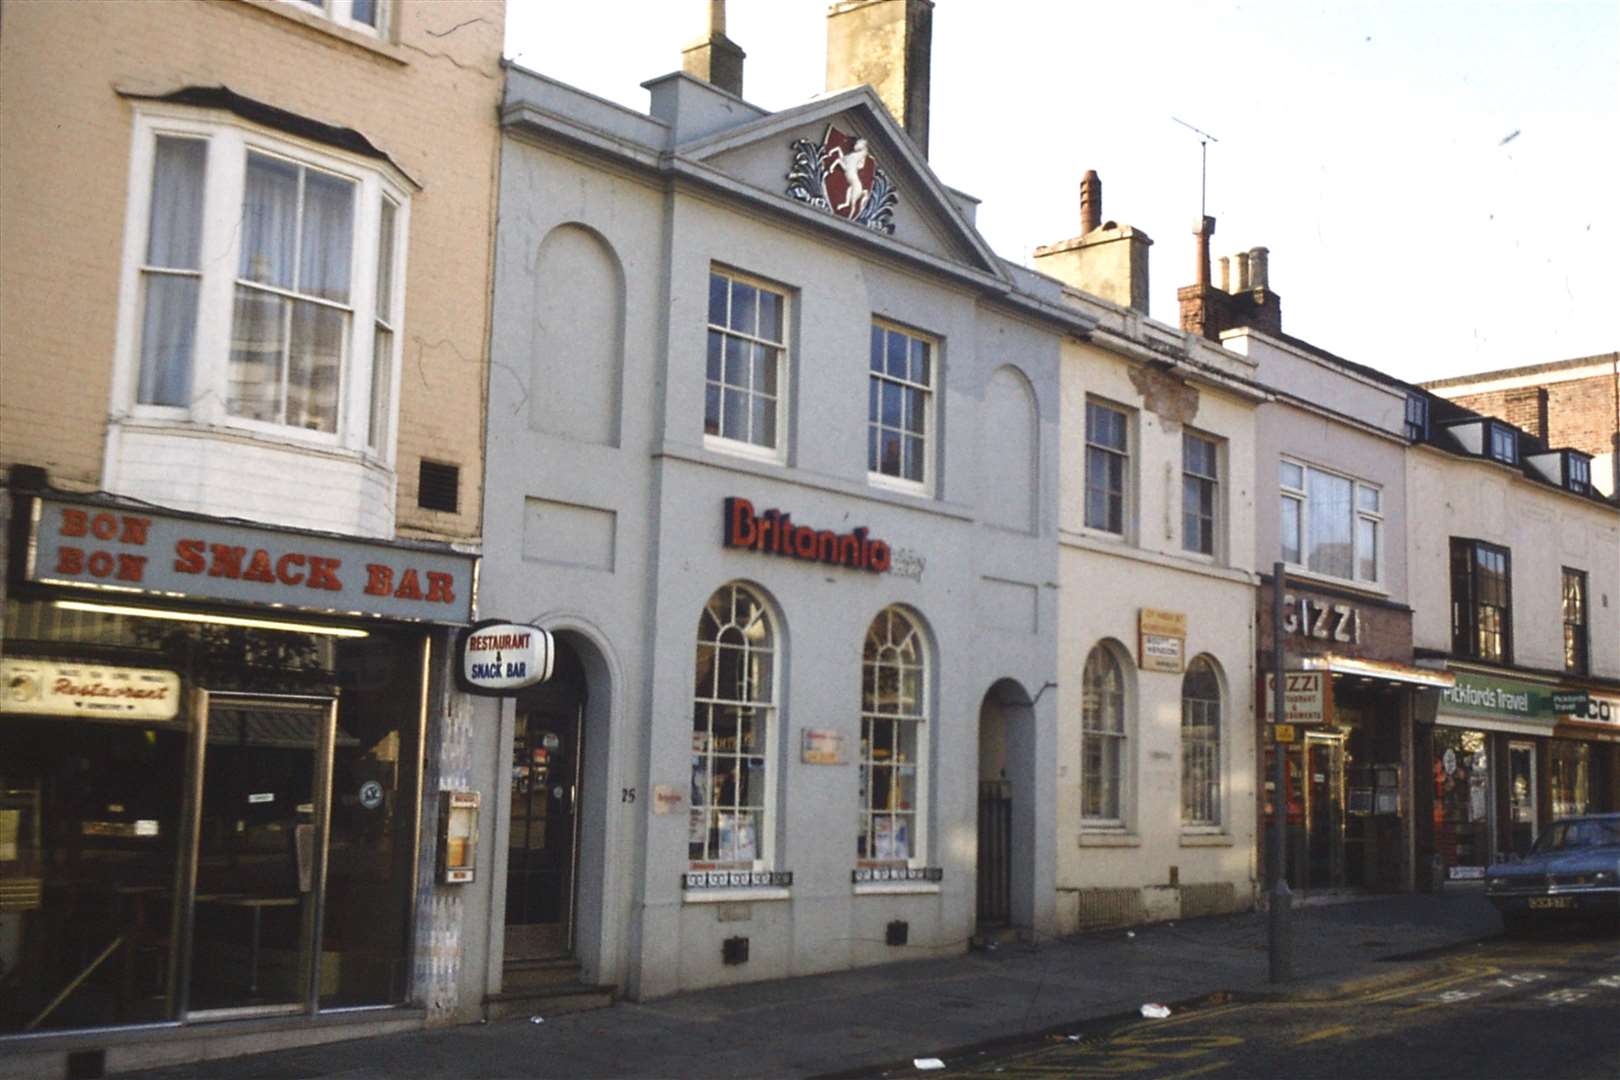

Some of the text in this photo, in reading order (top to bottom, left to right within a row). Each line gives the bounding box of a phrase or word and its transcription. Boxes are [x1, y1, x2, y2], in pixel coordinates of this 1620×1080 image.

[60, 509, 151, 545] BON
[724, 496, 891, 576] Britannia
[55, 546, 147, 582] BON
[174, 539, 455, 604] SNACK BAR
[1283, 594, 1360, 644] GIZZI
[469, 634, 530, 651] RESTAURANT
[472, 662, 526, 678] SNACK BAR
[53, 678, 168, 699] Restaurant
[1496, 689, 1528, 711] Travel
